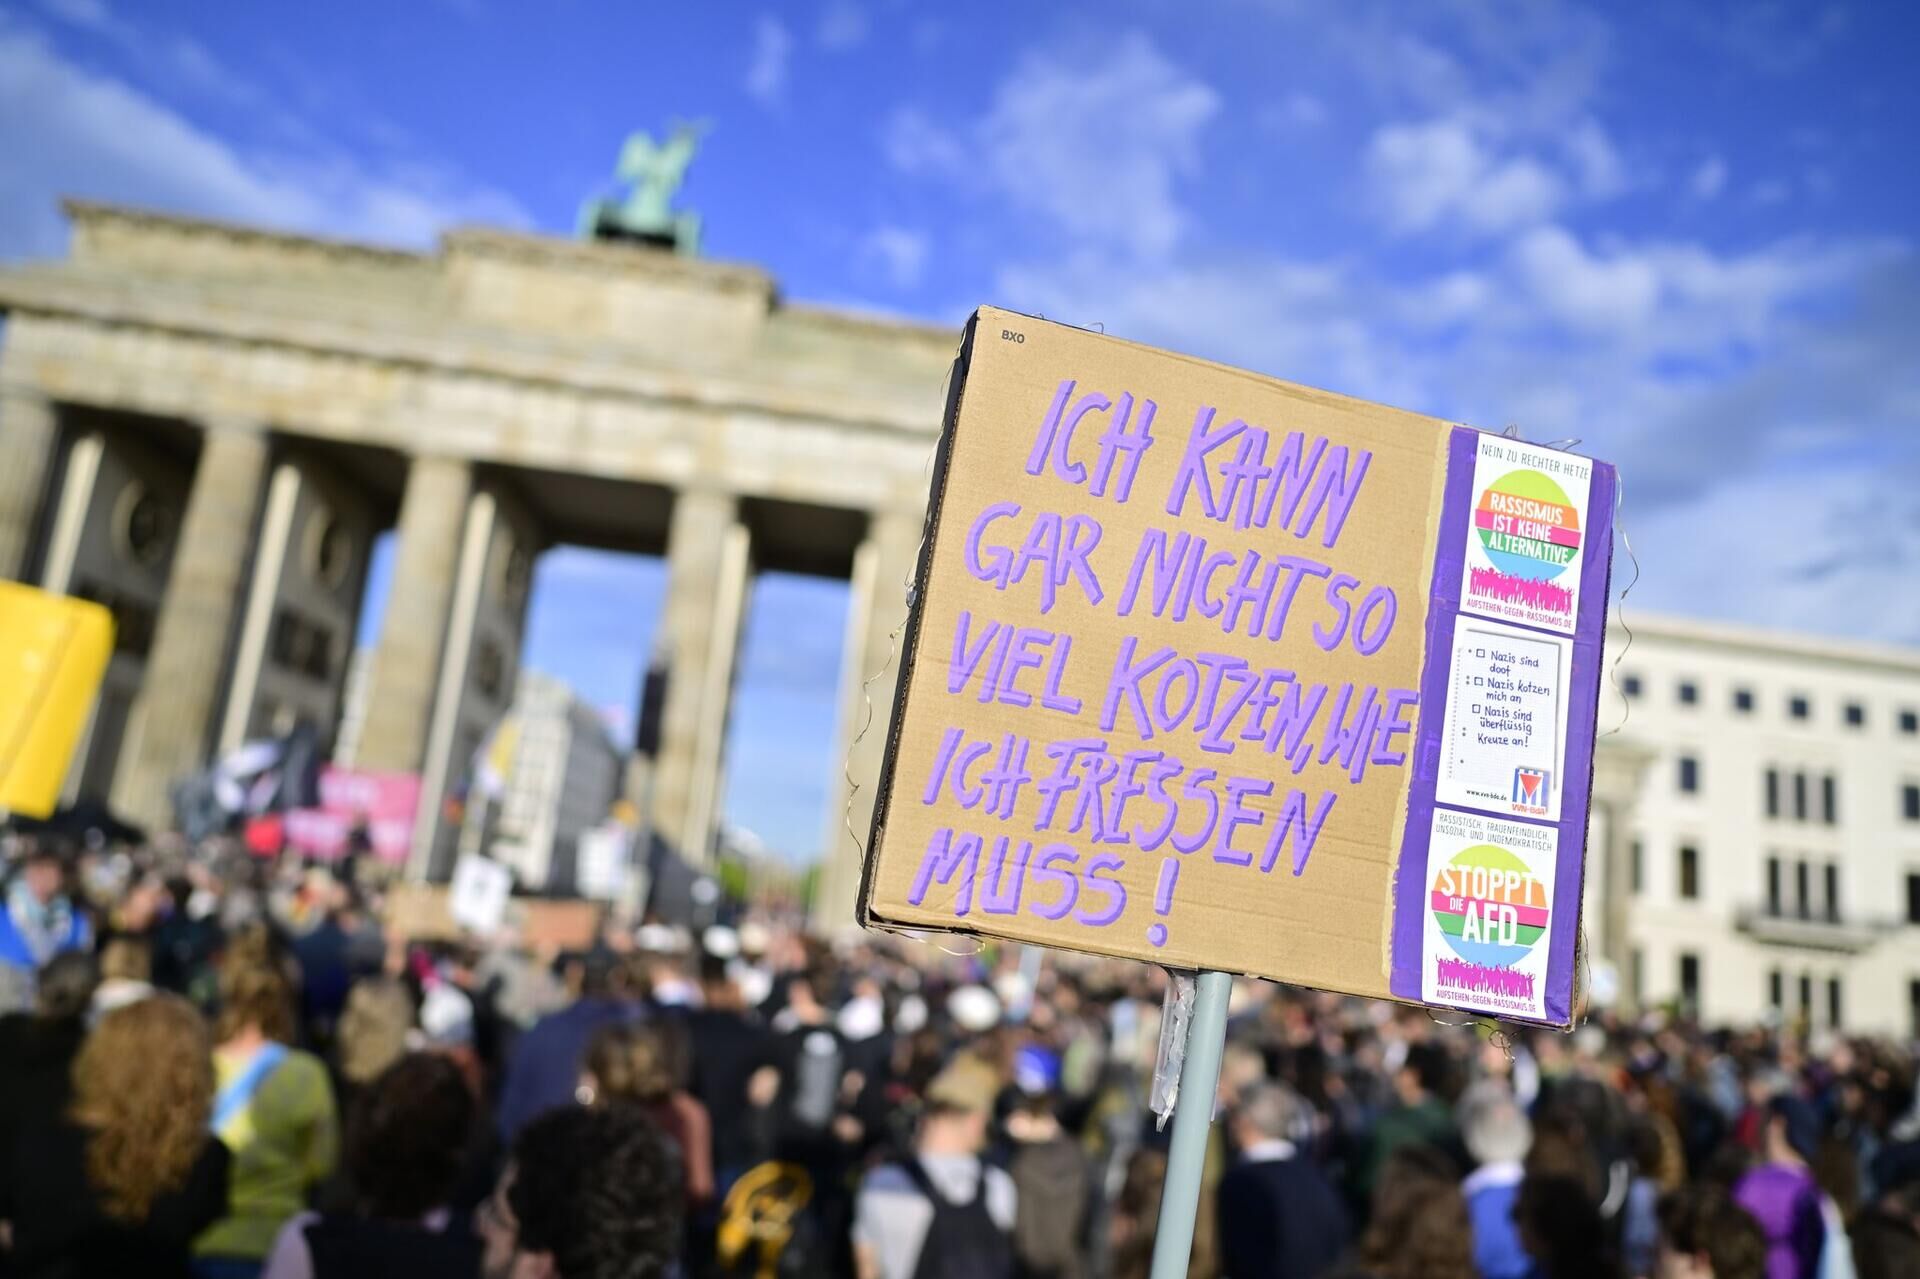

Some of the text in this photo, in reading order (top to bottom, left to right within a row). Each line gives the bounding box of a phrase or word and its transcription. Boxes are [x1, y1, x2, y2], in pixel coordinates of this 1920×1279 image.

[1001, 329, 1026, 344] BXO
[1025, 379, 1372, 548] ICH KANN
[1481, 444, 1589, 481] NEIN ZU RECHTER HETZE
[1490, 492, 1564, 526] RASSISMUS
[1492, 514, 1553, 542] IST KEINE
[1488, 533, 1569, 565] ALTERNATIVE
[964, 502, 1398, 656] GAR NICHT SO
[947, 610, 1082, 716] VIEL
[1489, 664, 1511, 678] doof
[1490, 650, 1540, 668] Nazis sind
[1486, 677, 1550, 696] Nazis kotzen
[1486, 690, 1522, 704] mich an
[1479, 716, 1533, 736] überflüssig
[1484, 705, 1533, 722] Nazis sind
[1477, 732, 1529, 748] Kreuze an!
[922, 727, 1338, 877] ICH FRESSEN
[1435, 825, 1553, 852] UNSOZIAL UND UNDEMOKRATISCH
[1439, 861, 1540, 905] STOPPT
[1450, 897, 1464, 912] DIE
[1461, 900, 1518, 947] AFD
